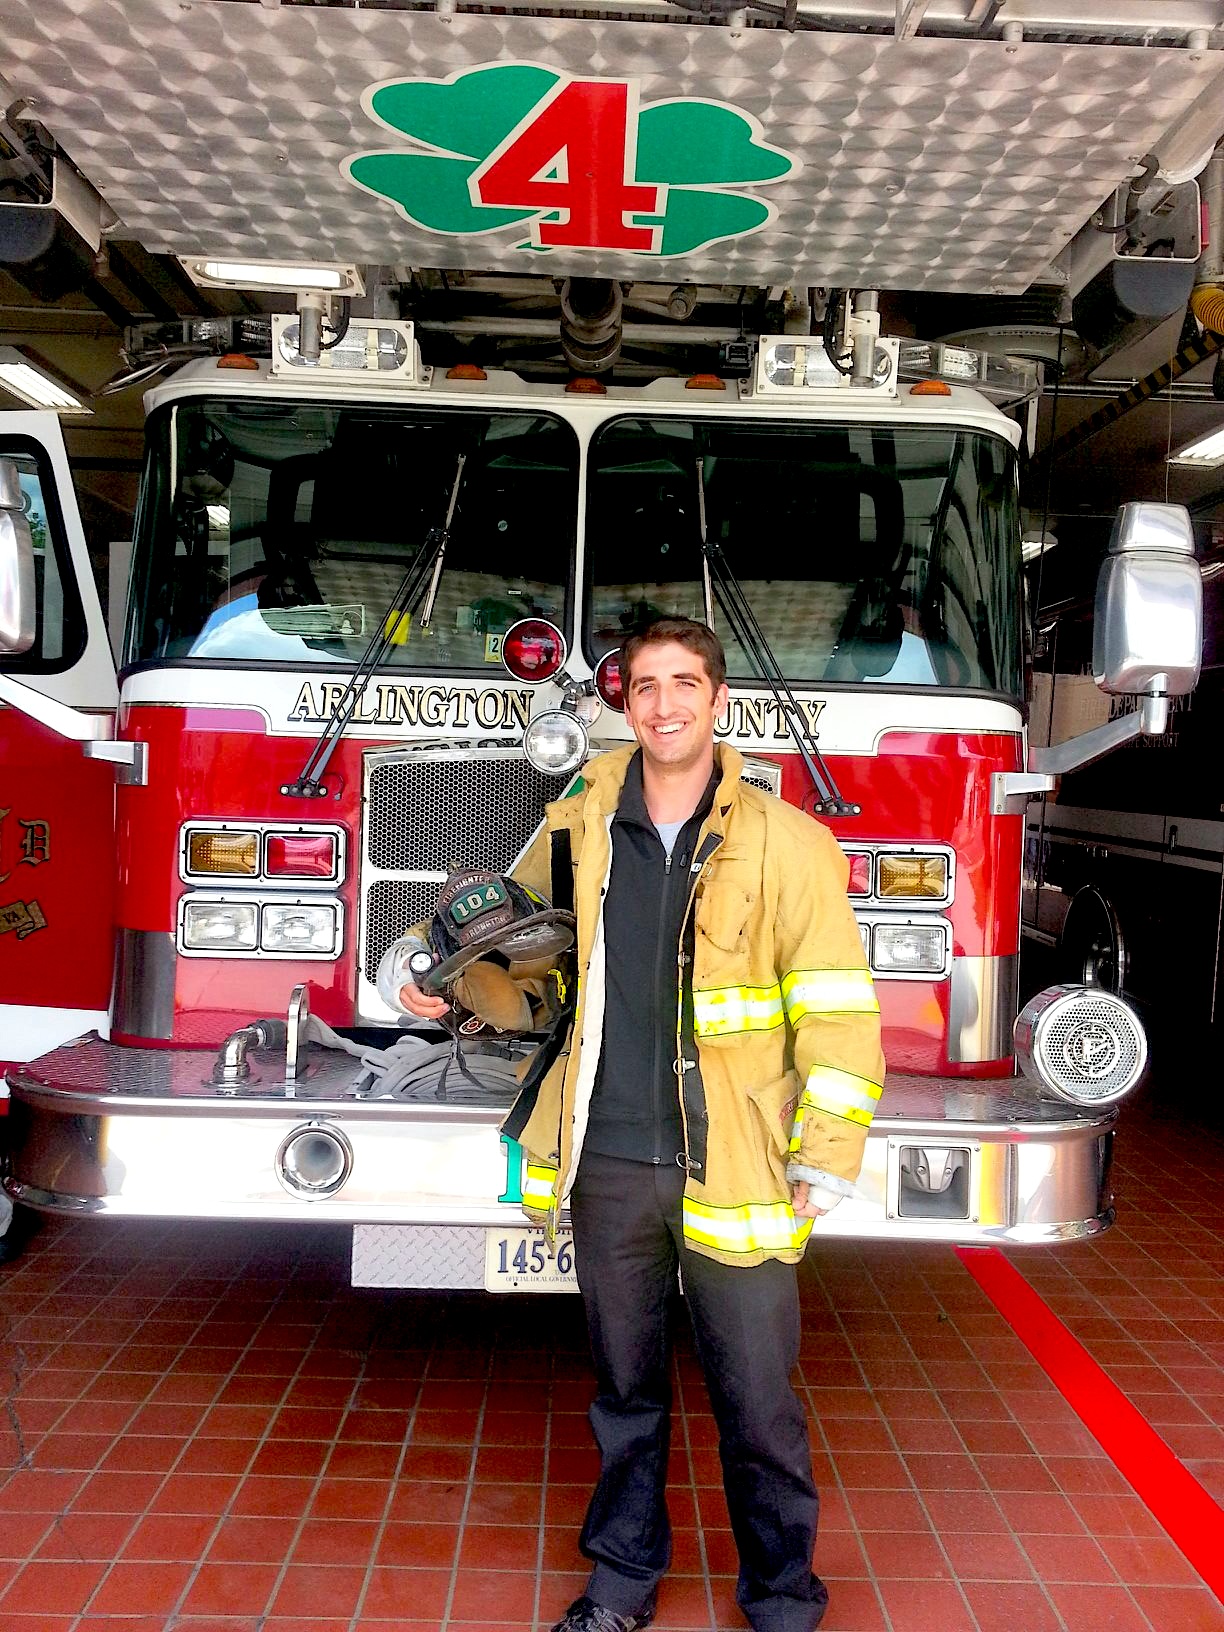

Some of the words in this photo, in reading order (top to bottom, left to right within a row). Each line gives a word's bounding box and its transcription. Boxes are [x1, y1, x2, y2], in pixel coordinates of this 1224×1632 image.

[477, 80, 659, 251] 4
[287, 682, 535, 730] ARLINGTON
[713, 698, 827, 739] UNTY
[456, 886, 500, 917] 104
